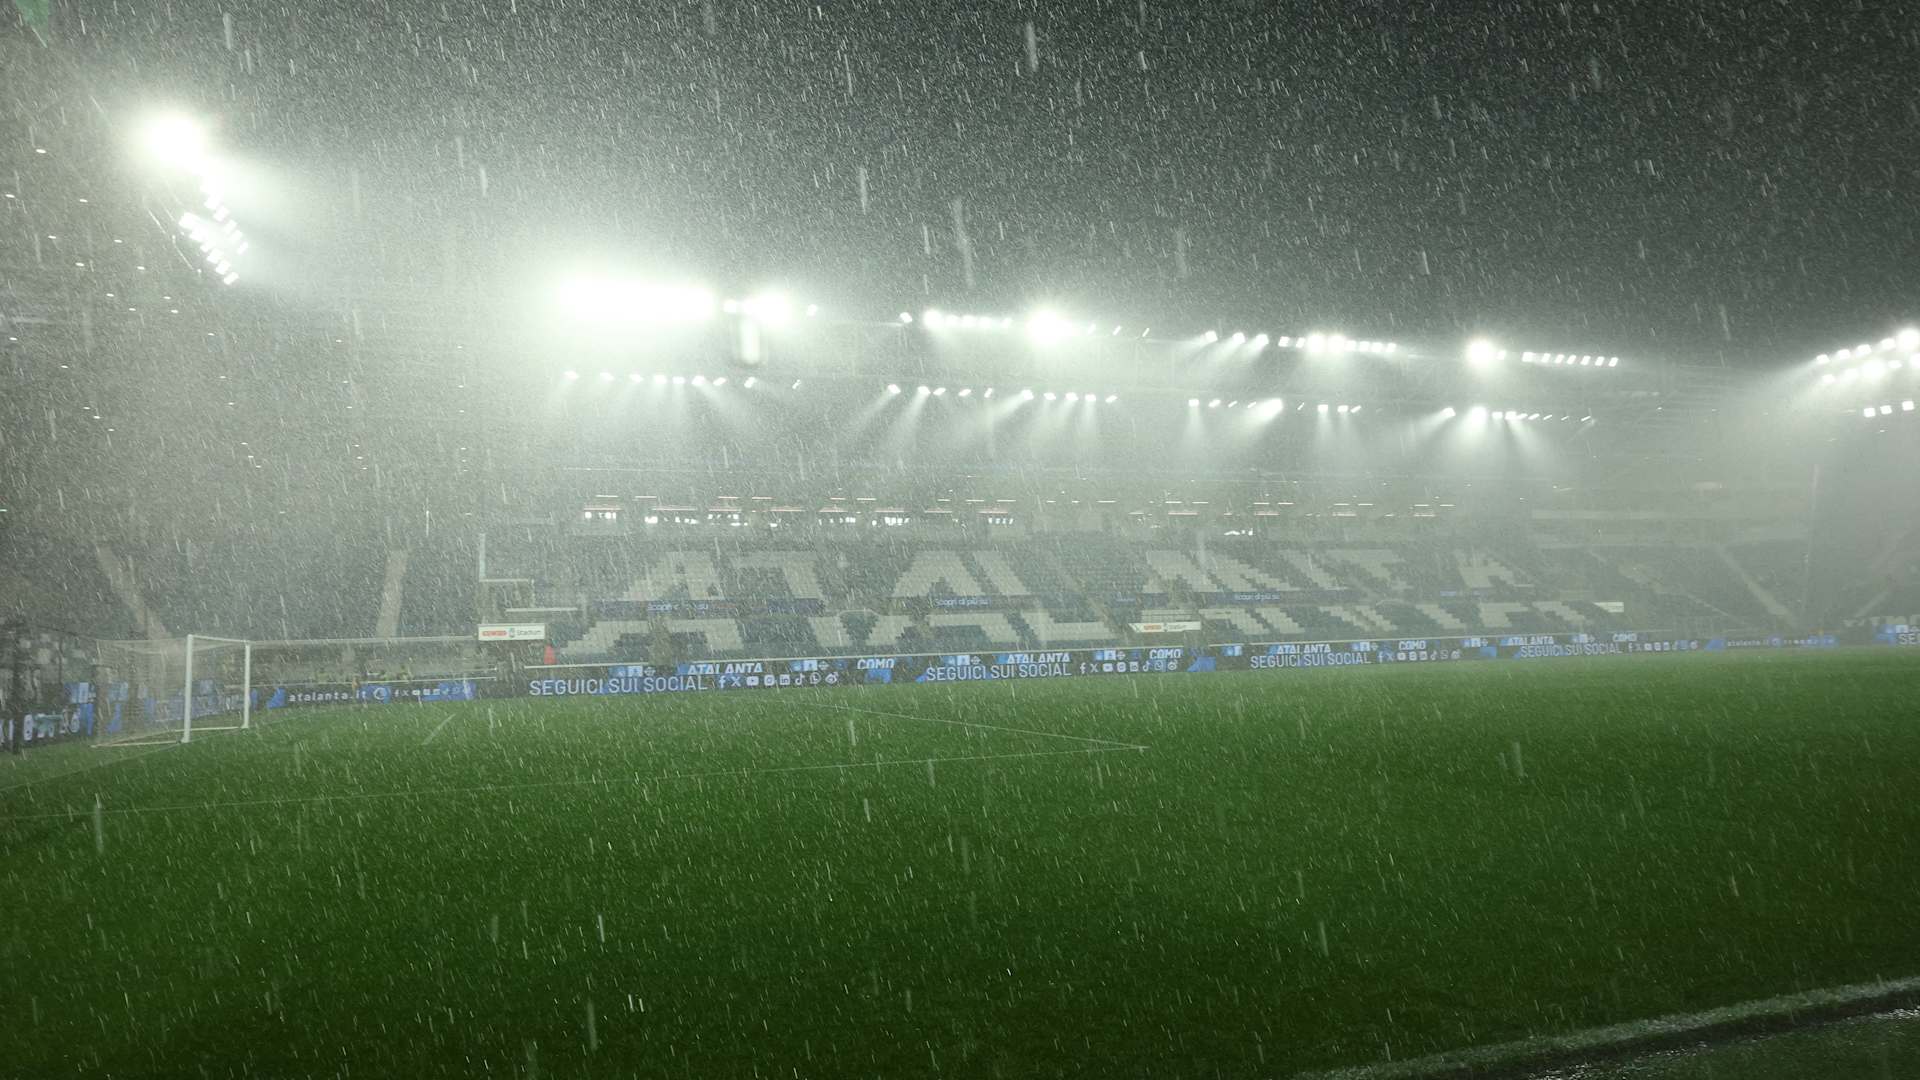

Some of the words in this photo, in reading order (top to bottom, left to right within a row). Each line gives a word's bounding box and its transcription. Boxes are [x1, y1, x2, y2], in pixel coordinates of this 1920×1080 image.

[1398, 640, 1427, 650] COMO
[1507, 636, 1554, 646] ATALANTA
[1149, 648, 1182, 659] COMO
[1277, 643, 1331, 654] ATALANTA
[1520, 645, 1563, 658] SEGUICI
[1566, 644, 1582, 656] SUI
[1584, 642, 1623, 655] SOCIAL
[857, 658, 896, 670] COMO
[1007, 652, 1070, 664] ATALANTA
[1250, 654, 1300, 669] SEGUICI
[1303, 653, 1325, 666] SUI
[1327, 652, 1372, 665] SOCIAL
[687, 662, 763, 675] ATALANTA
[926, 666, 987, 681] SEGUICI
[990, 665, 1015, 679] SUI
[1018, 663, 1072, 678] SOCIAL
[529, 679, 604, 696] SEGUICI
[608, 677, 639, 693] SUI
[643, 676, 708, 692] SOCIAL
[289, 691, 367, 702] atalanta.it
